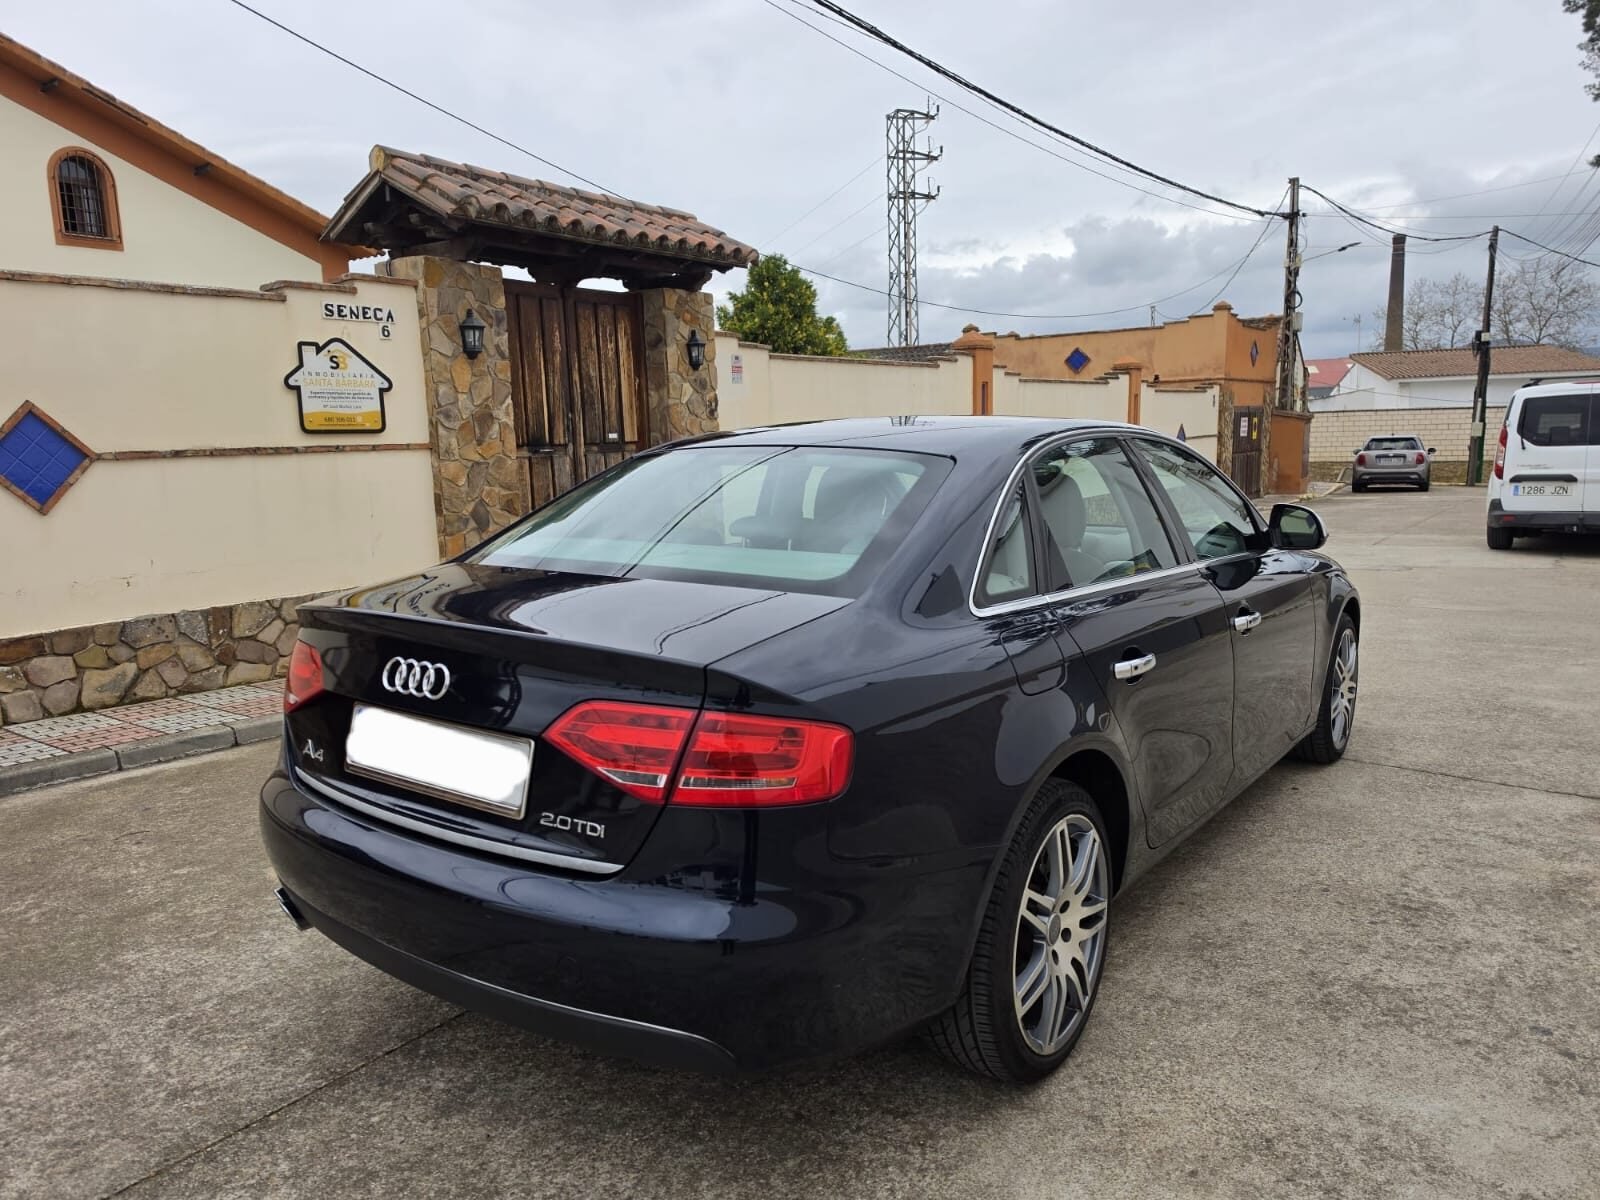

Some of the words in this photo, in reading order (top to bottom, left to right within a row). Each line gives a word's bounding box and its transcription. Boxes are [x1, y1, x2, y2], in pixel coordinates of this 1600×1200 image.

[324, 303, 394, 322] SENECA
[381, 325, 391, 338] 6
[303, 378, 333, 387] SANTA
[1522, 486, 1545, 495] 1286
[1551, 486, 1569, 495] JZN
[302, 739, 324, 762] A4
